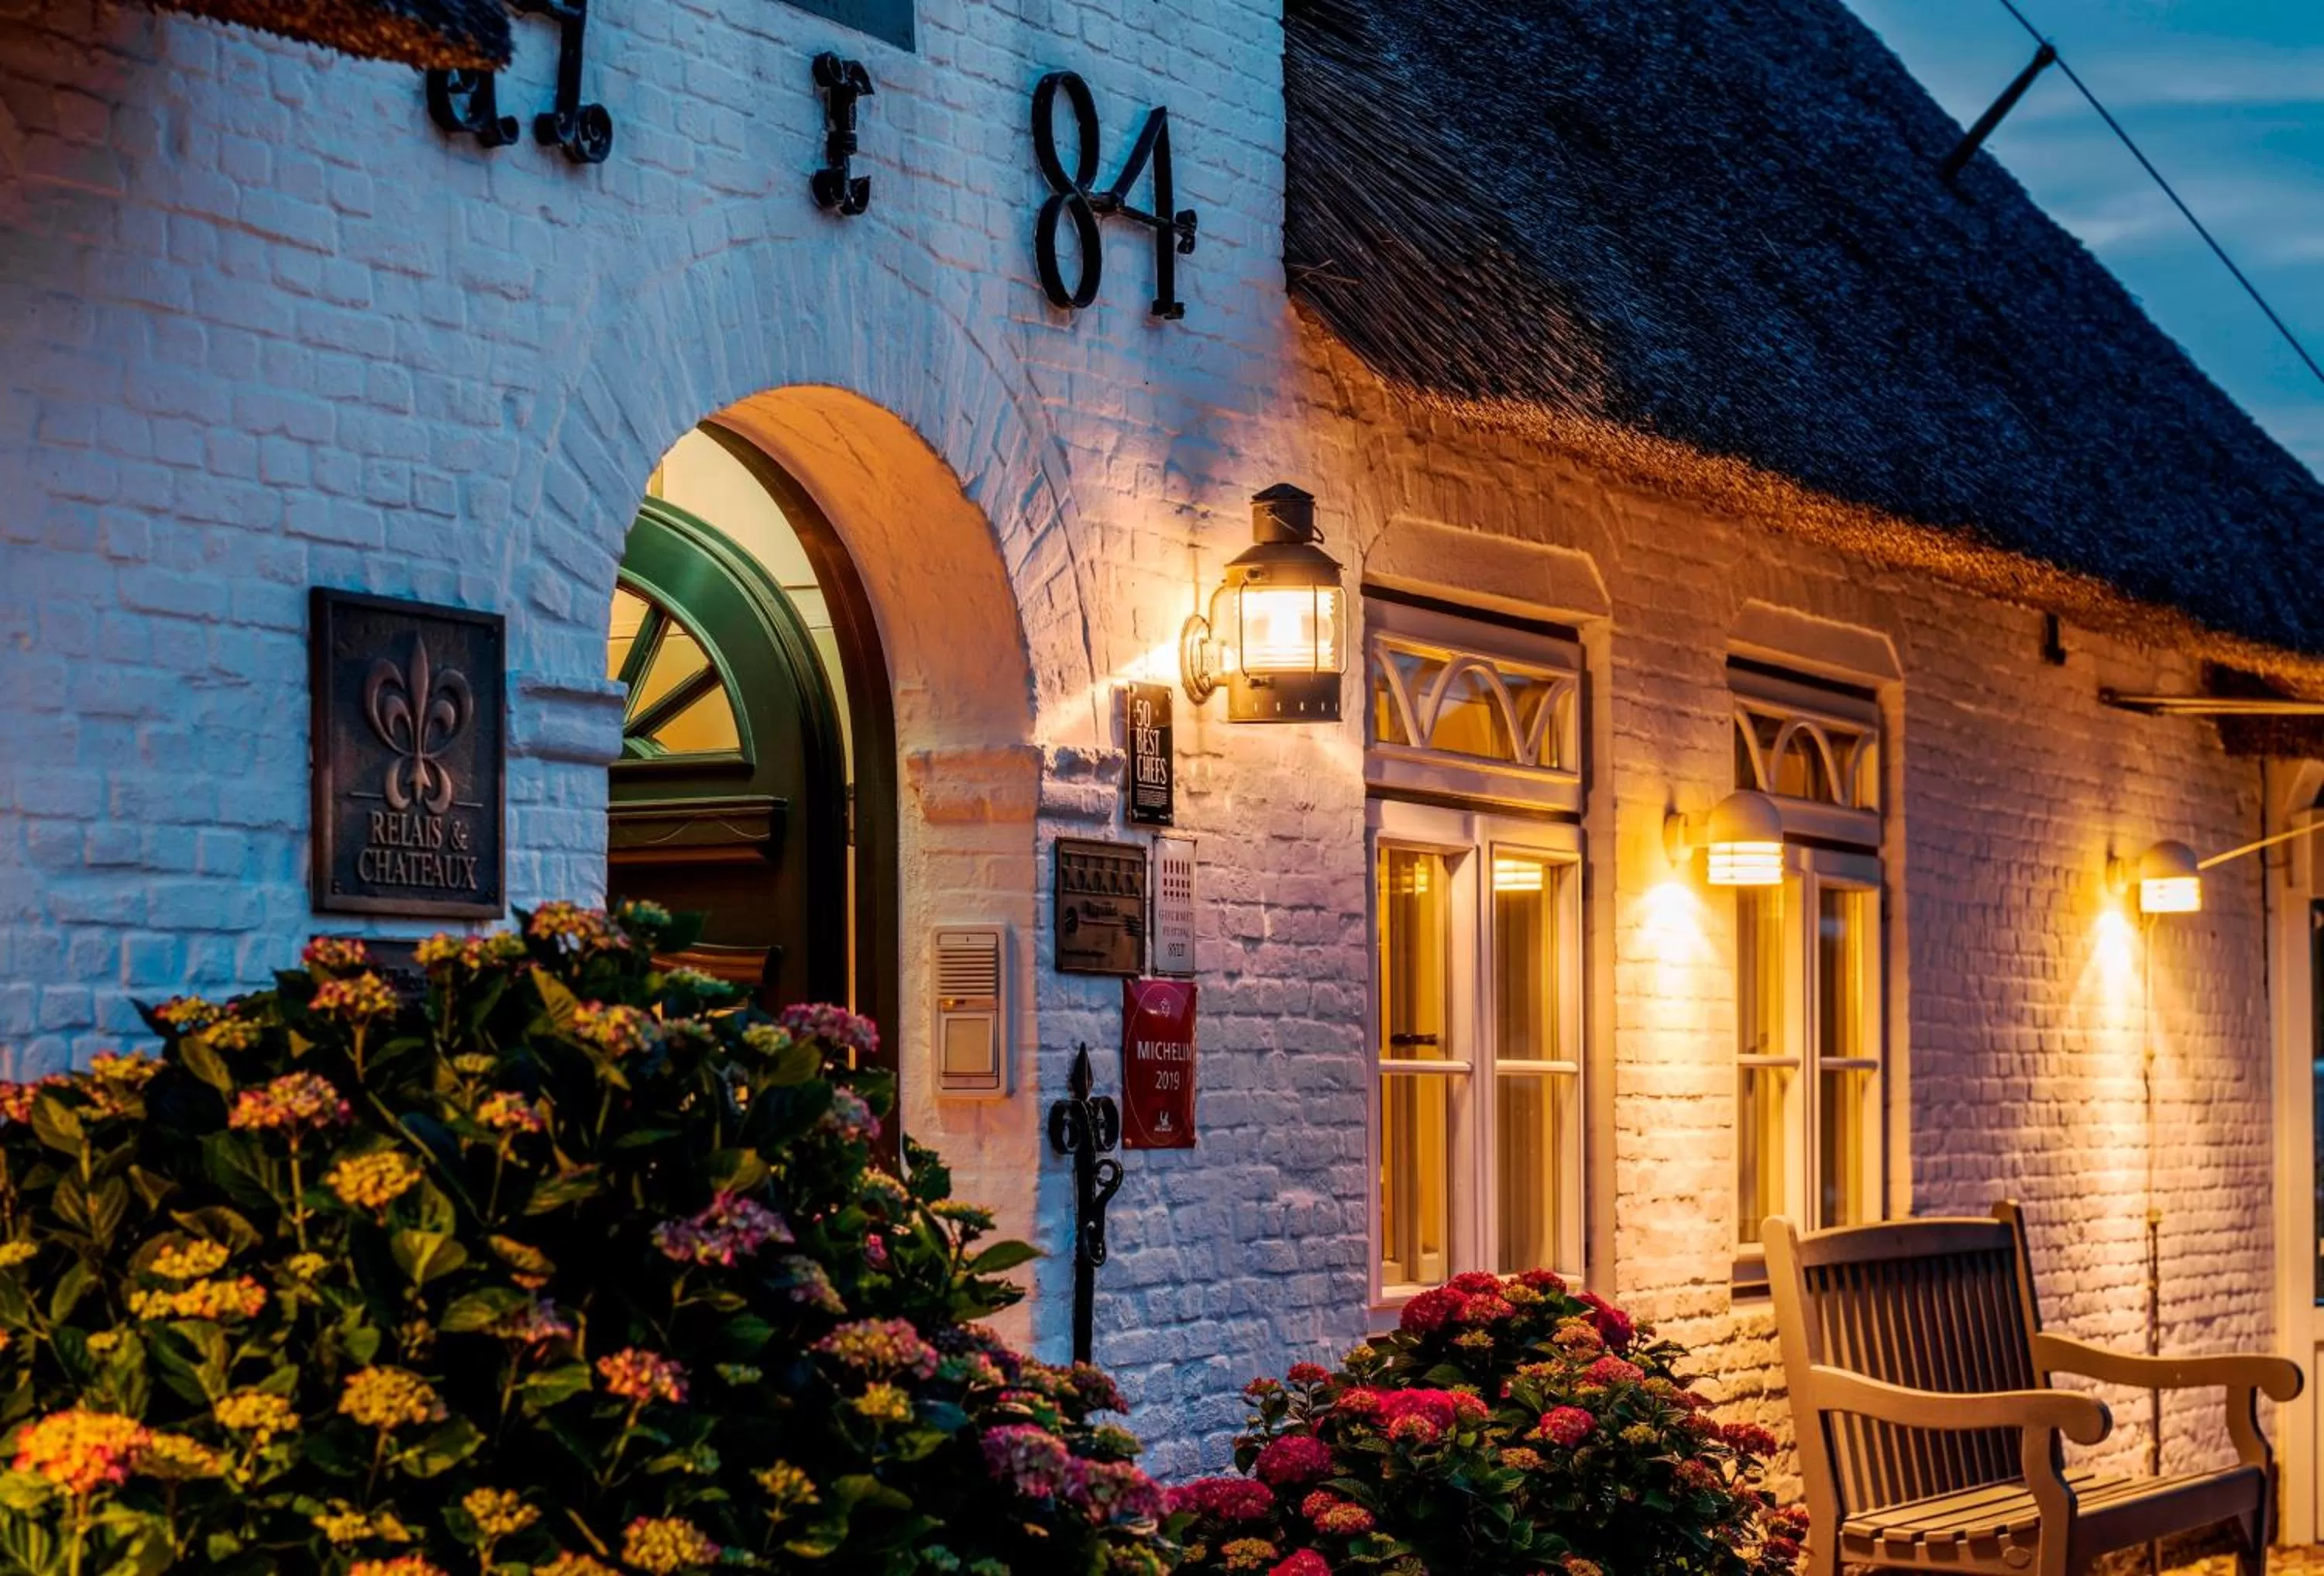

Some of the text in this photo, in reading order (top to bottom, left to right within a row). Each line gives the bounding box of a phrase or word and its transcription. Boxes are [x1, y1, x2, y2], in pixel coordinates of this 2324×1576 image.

[1136, 700, 1150, 728] 50
[1136, 728, 1160, 757] BEST
[1136, 756, 1167, 785] CHEFS
[371, 810, 469, 851] RELAIS &
[357, 847, 478, 891] CHATEAUX
[1136, 1041, 1192, 1062] MICHELIN
[1155, 1071, 1181, 1091] 2019
